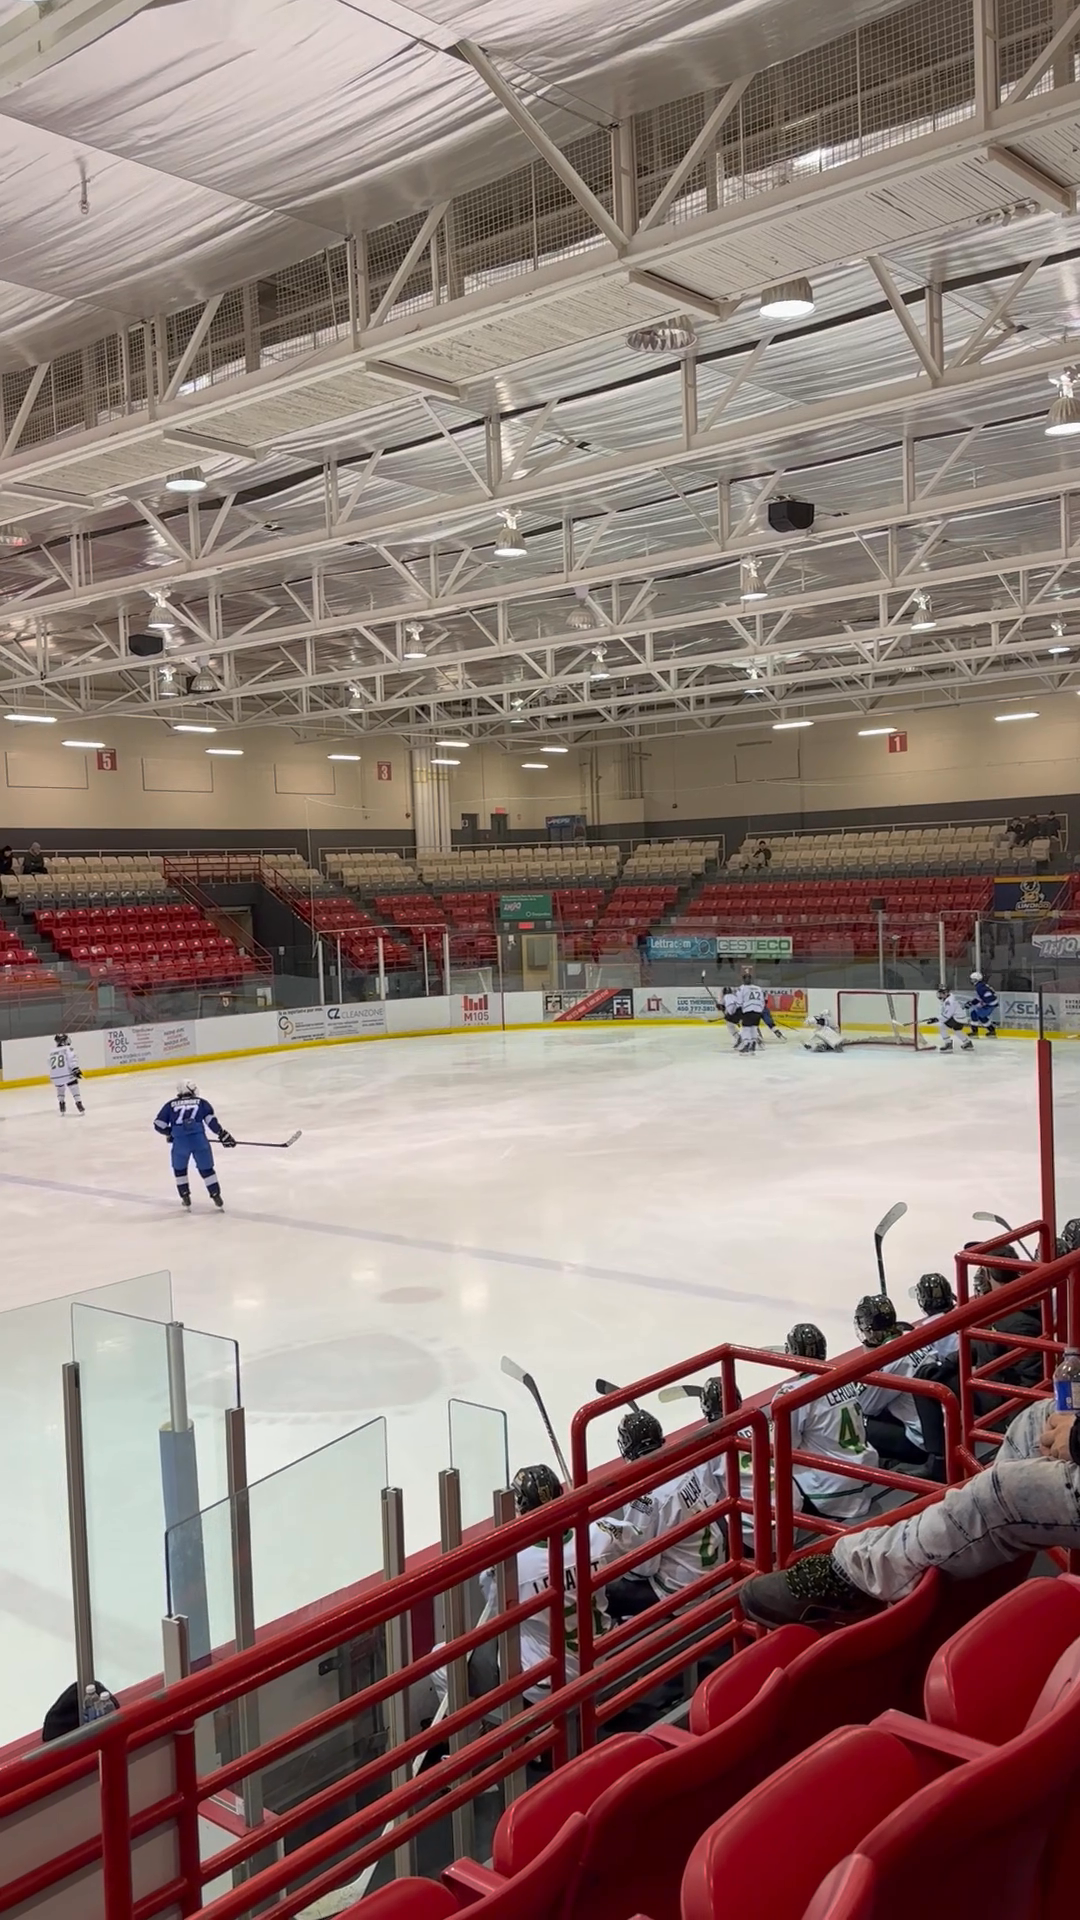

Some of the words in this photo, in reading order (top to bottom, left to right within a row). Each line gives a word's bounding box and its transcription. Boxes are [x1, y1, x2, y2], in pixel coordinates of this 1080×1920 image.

[894, 736, 900, 751] 1
[103, 753, 111, 770] 5
[381, 765, 388, 780] 3
[718, 940, 791, 951] GESTECO
[327, 1008, 340, 1019] CZ
[341, 1008, 383, 1019] CLEANZONE
[464, 1012, 489, 1021] M105
[115, 1038, 129, 1046] DEL
[115, 1045, 127, 1053] CO
[50, 1055, 65, 1070] 28
[173, 1105, 199, 1125] 77
